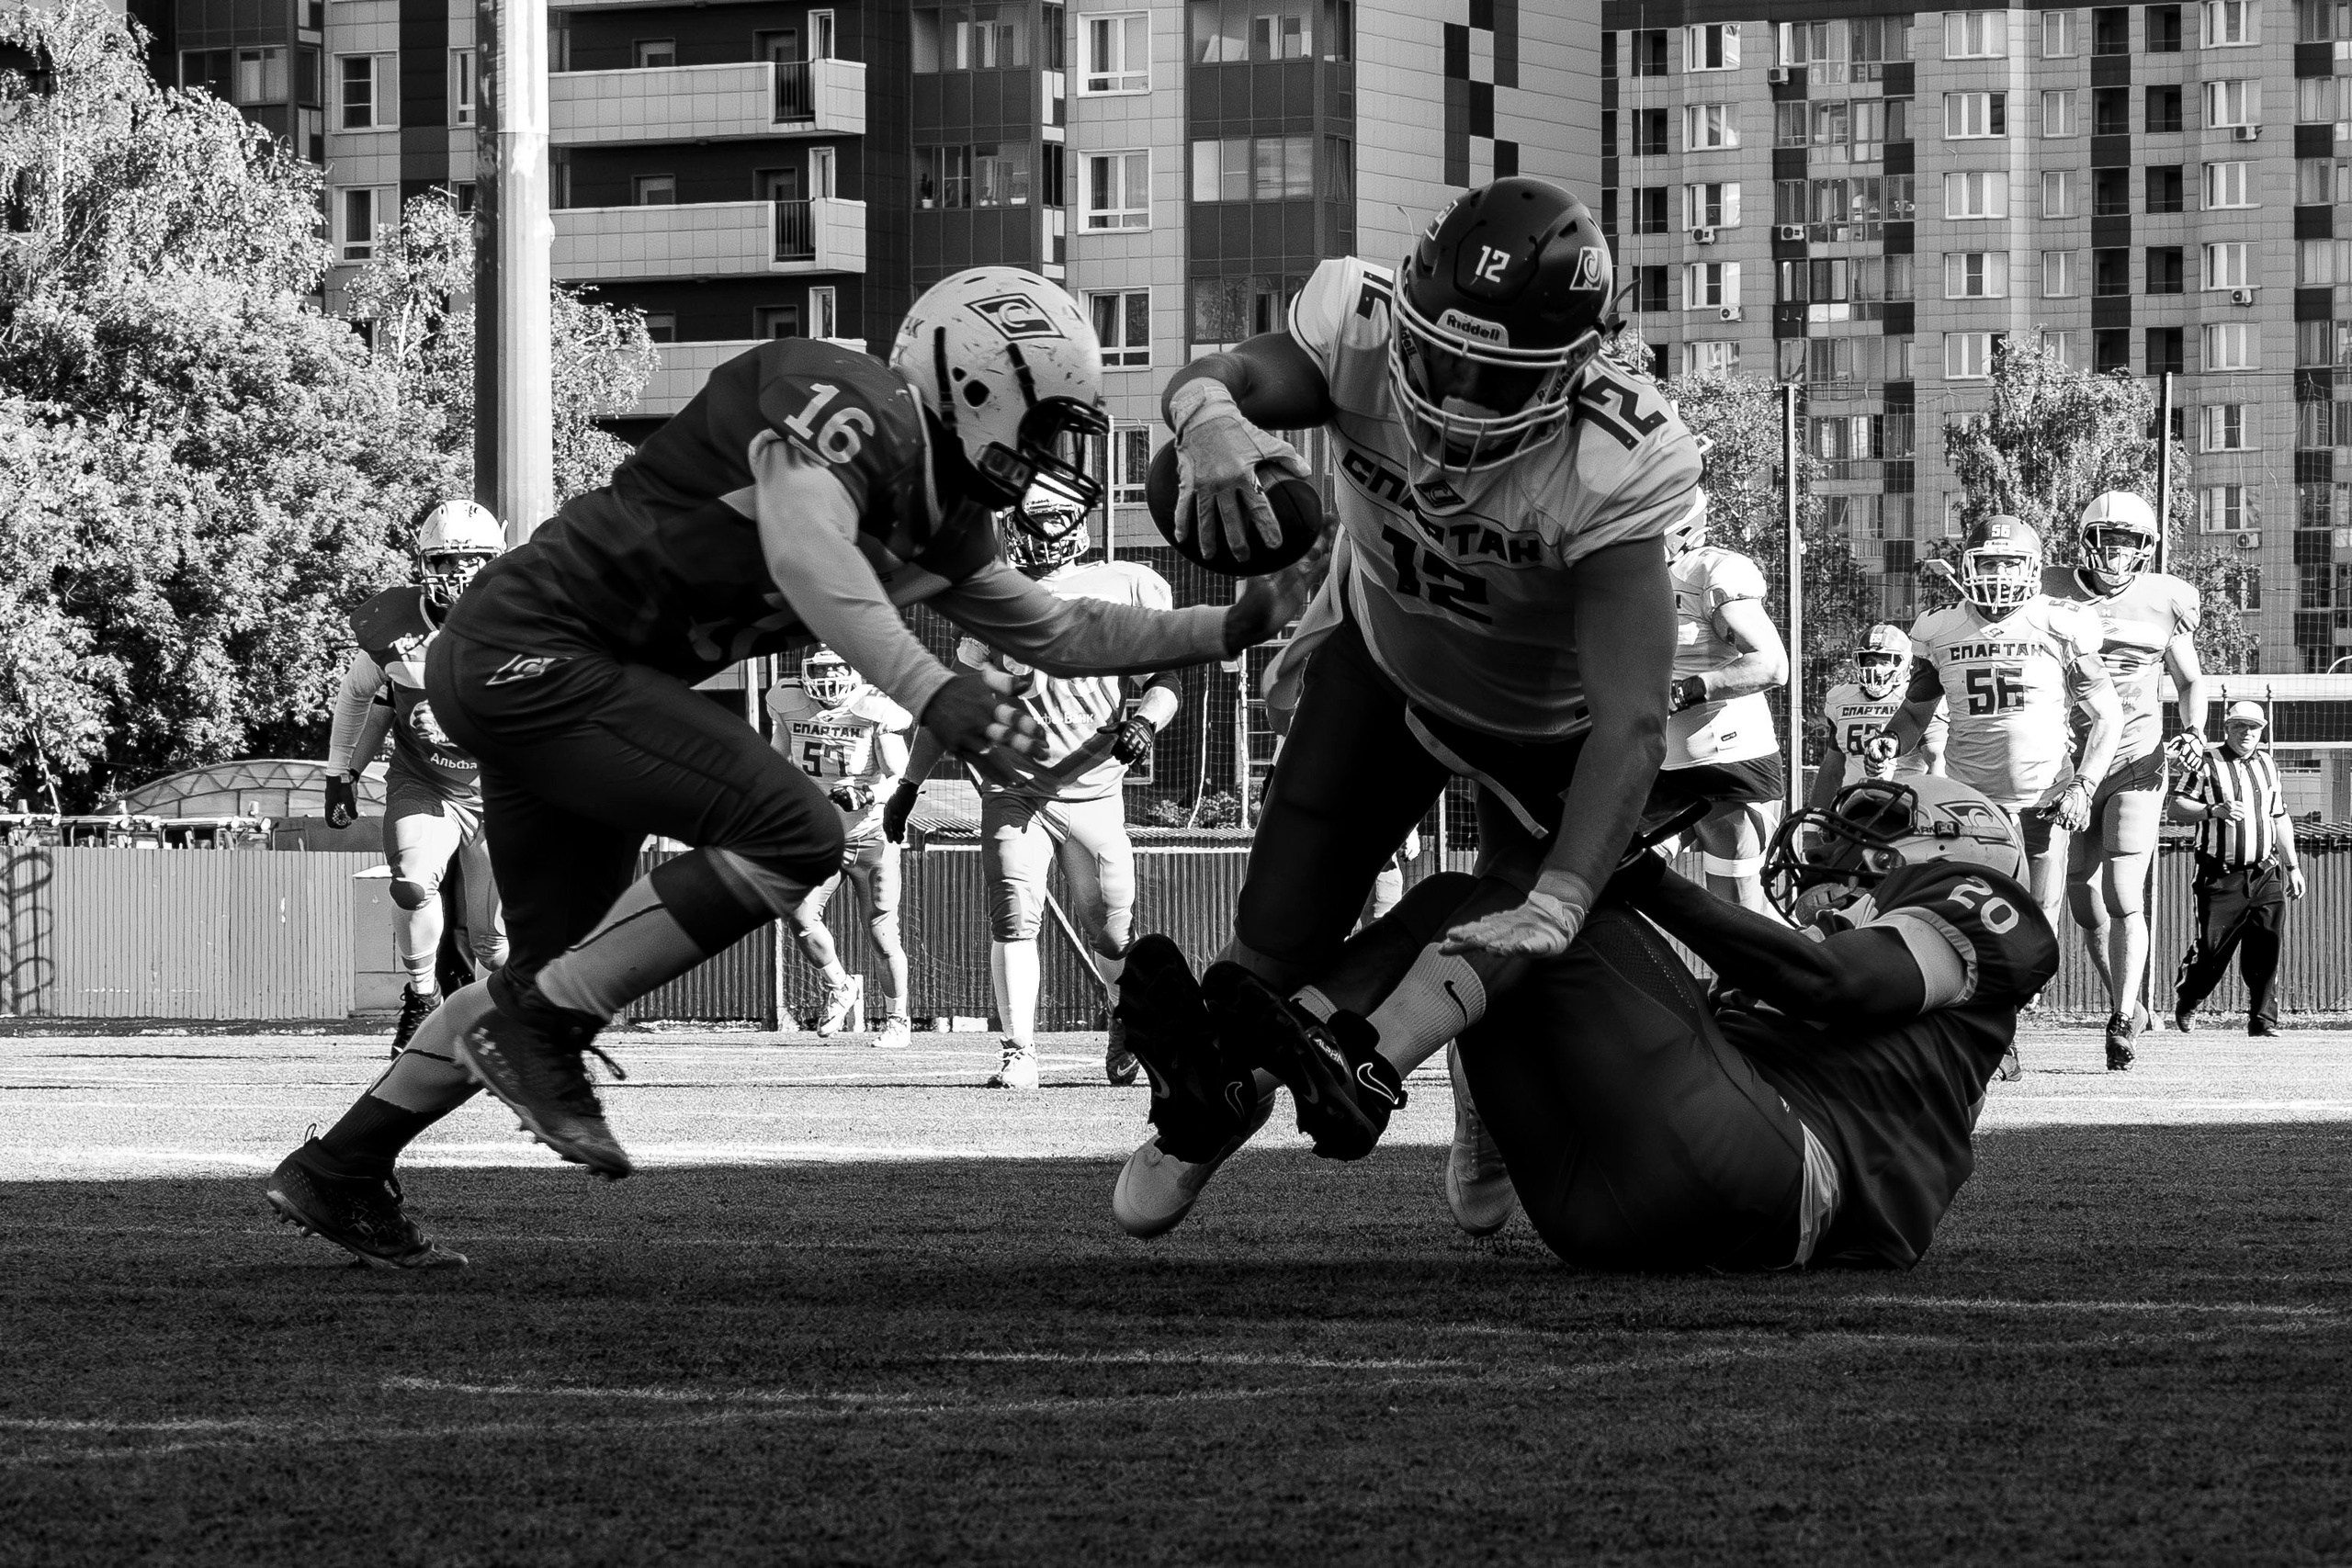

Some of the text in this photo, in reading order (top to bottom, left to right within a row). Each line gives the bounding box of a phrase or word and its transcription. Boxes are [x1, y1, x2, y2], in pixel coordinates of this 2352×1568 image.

[1475, 244, 1511, 283] 12
[1446, 314, 1500, 341] Riddell
[784, 383, 875, 463] 16
[1575, 375, 1668, 451] 12
[1991, 524, 2011, 538] 56
[1381, 524, 1493, 625] 12
[1949, 643, 2043, 661] СПАРТАК
[1966, 668, 2025, 716] 56
[793, 722, 863, 739] СПАРТАК
[801, 740, 848, 778] 57
[1947, 875, 2019, 934] 20
